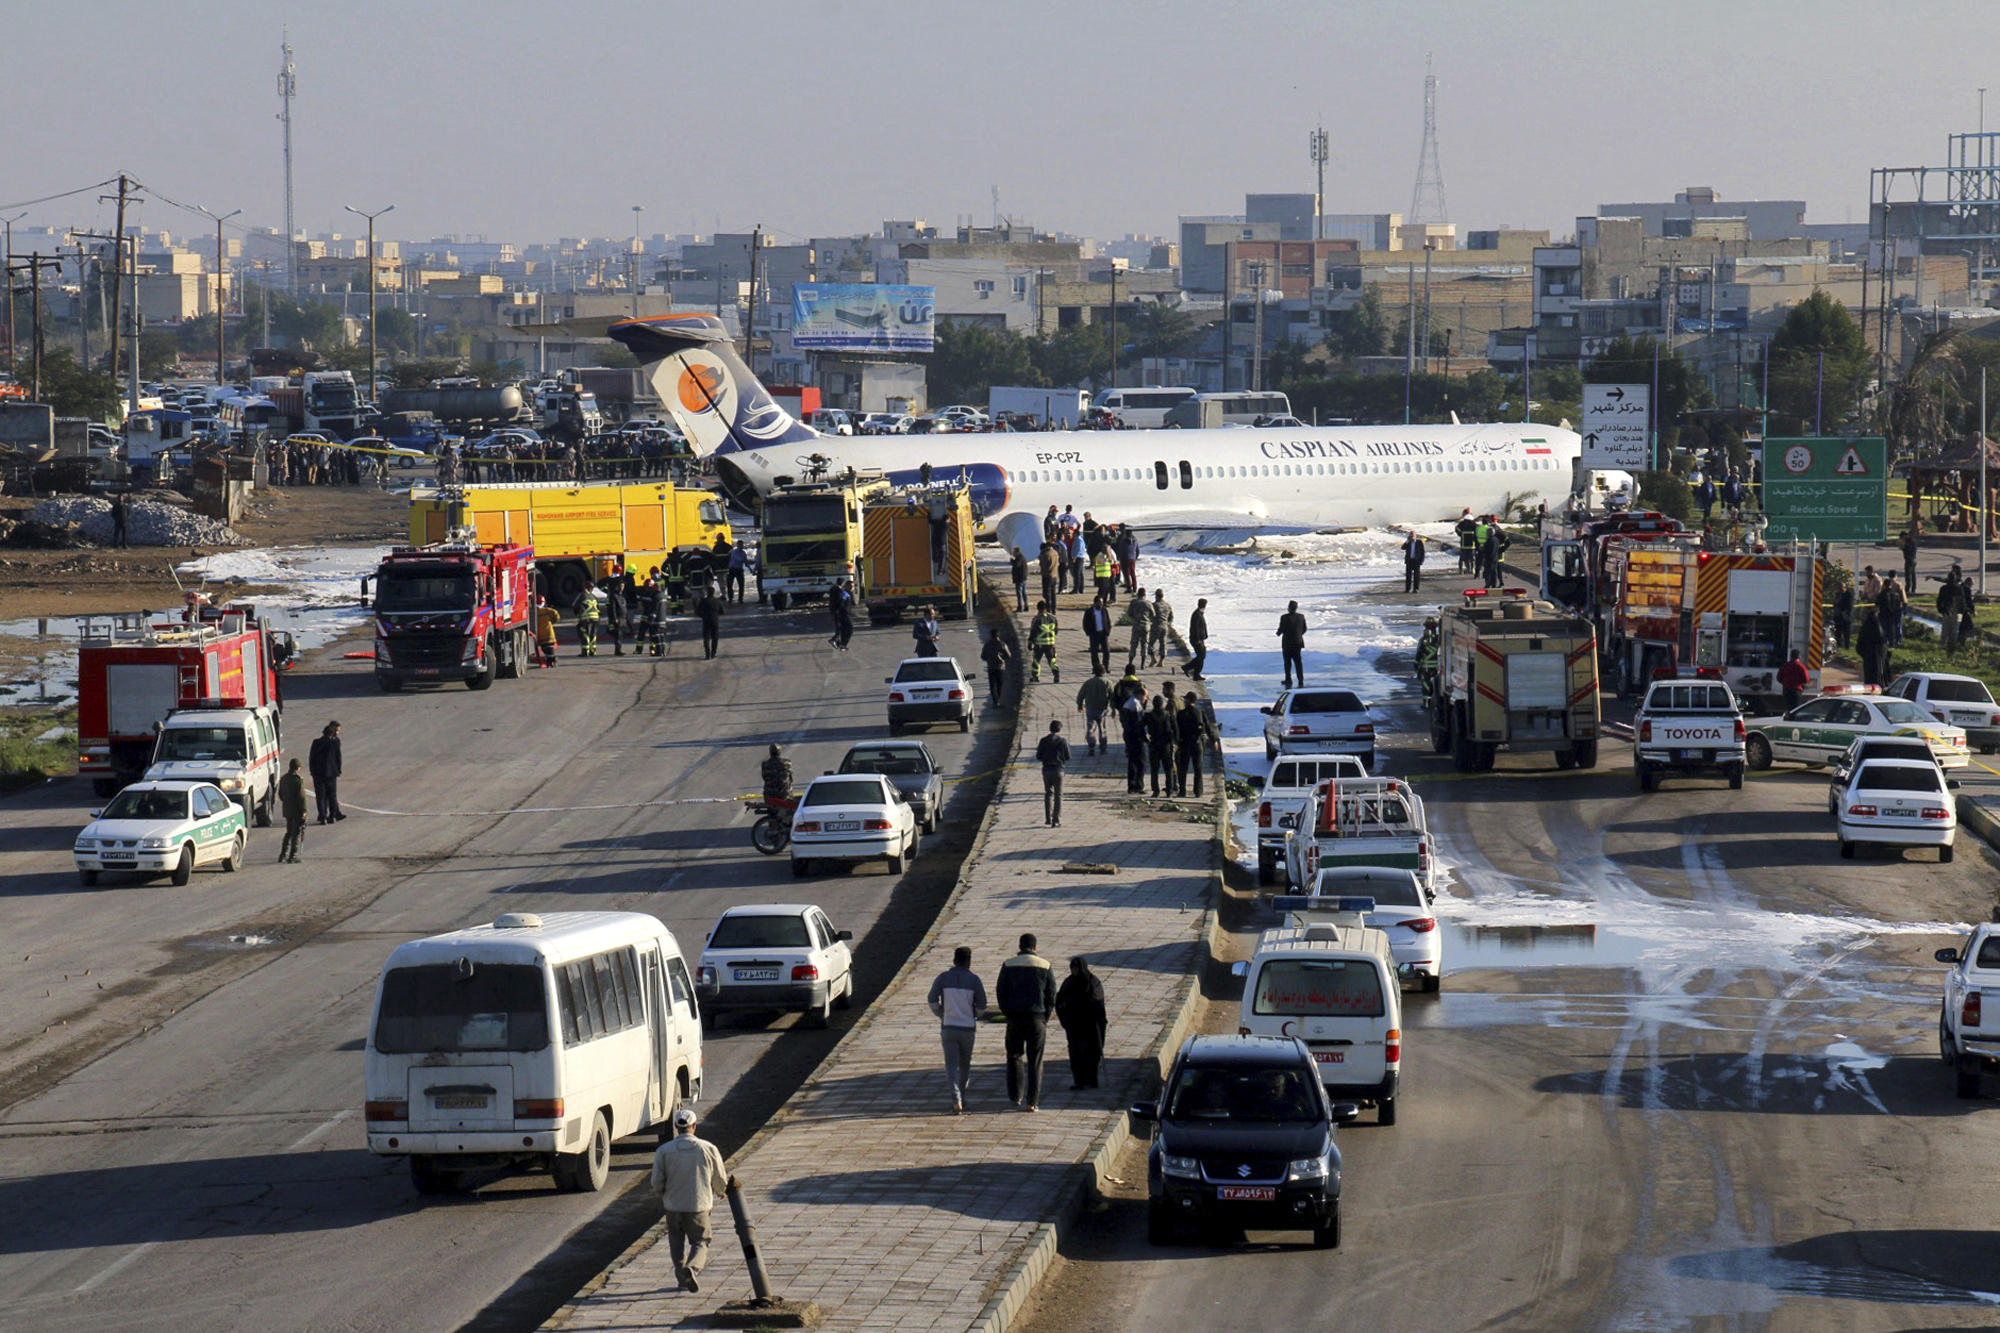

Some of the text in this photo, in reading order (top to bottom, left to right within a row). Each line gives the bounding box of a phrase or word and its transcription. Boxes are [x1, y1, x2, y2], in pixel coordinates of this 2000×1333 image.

[1590, 402, 1644, 414] مرکز شهر
[1260, 440, 1444, 460] CASPIAN AIRLINES
[1459, 440, 1478, 456] کاسپین
[1036, 452, 1083, 464] EP-CPZ
[1792, 450, 1804, 459] ۵۰
[1615, 457, 1643, 466] امیدیه
[1791, 460, 1804, 468] 50
[565, 511, 585, 519] AIRPORT
[597, 510, 617, 518] SERVICE
[1790, 505, 1858, 515] Reduce Speed
[1864, 524, 1879, 533] ۱۰۰
[1664, 729, 1721, 739] TOYOTA
